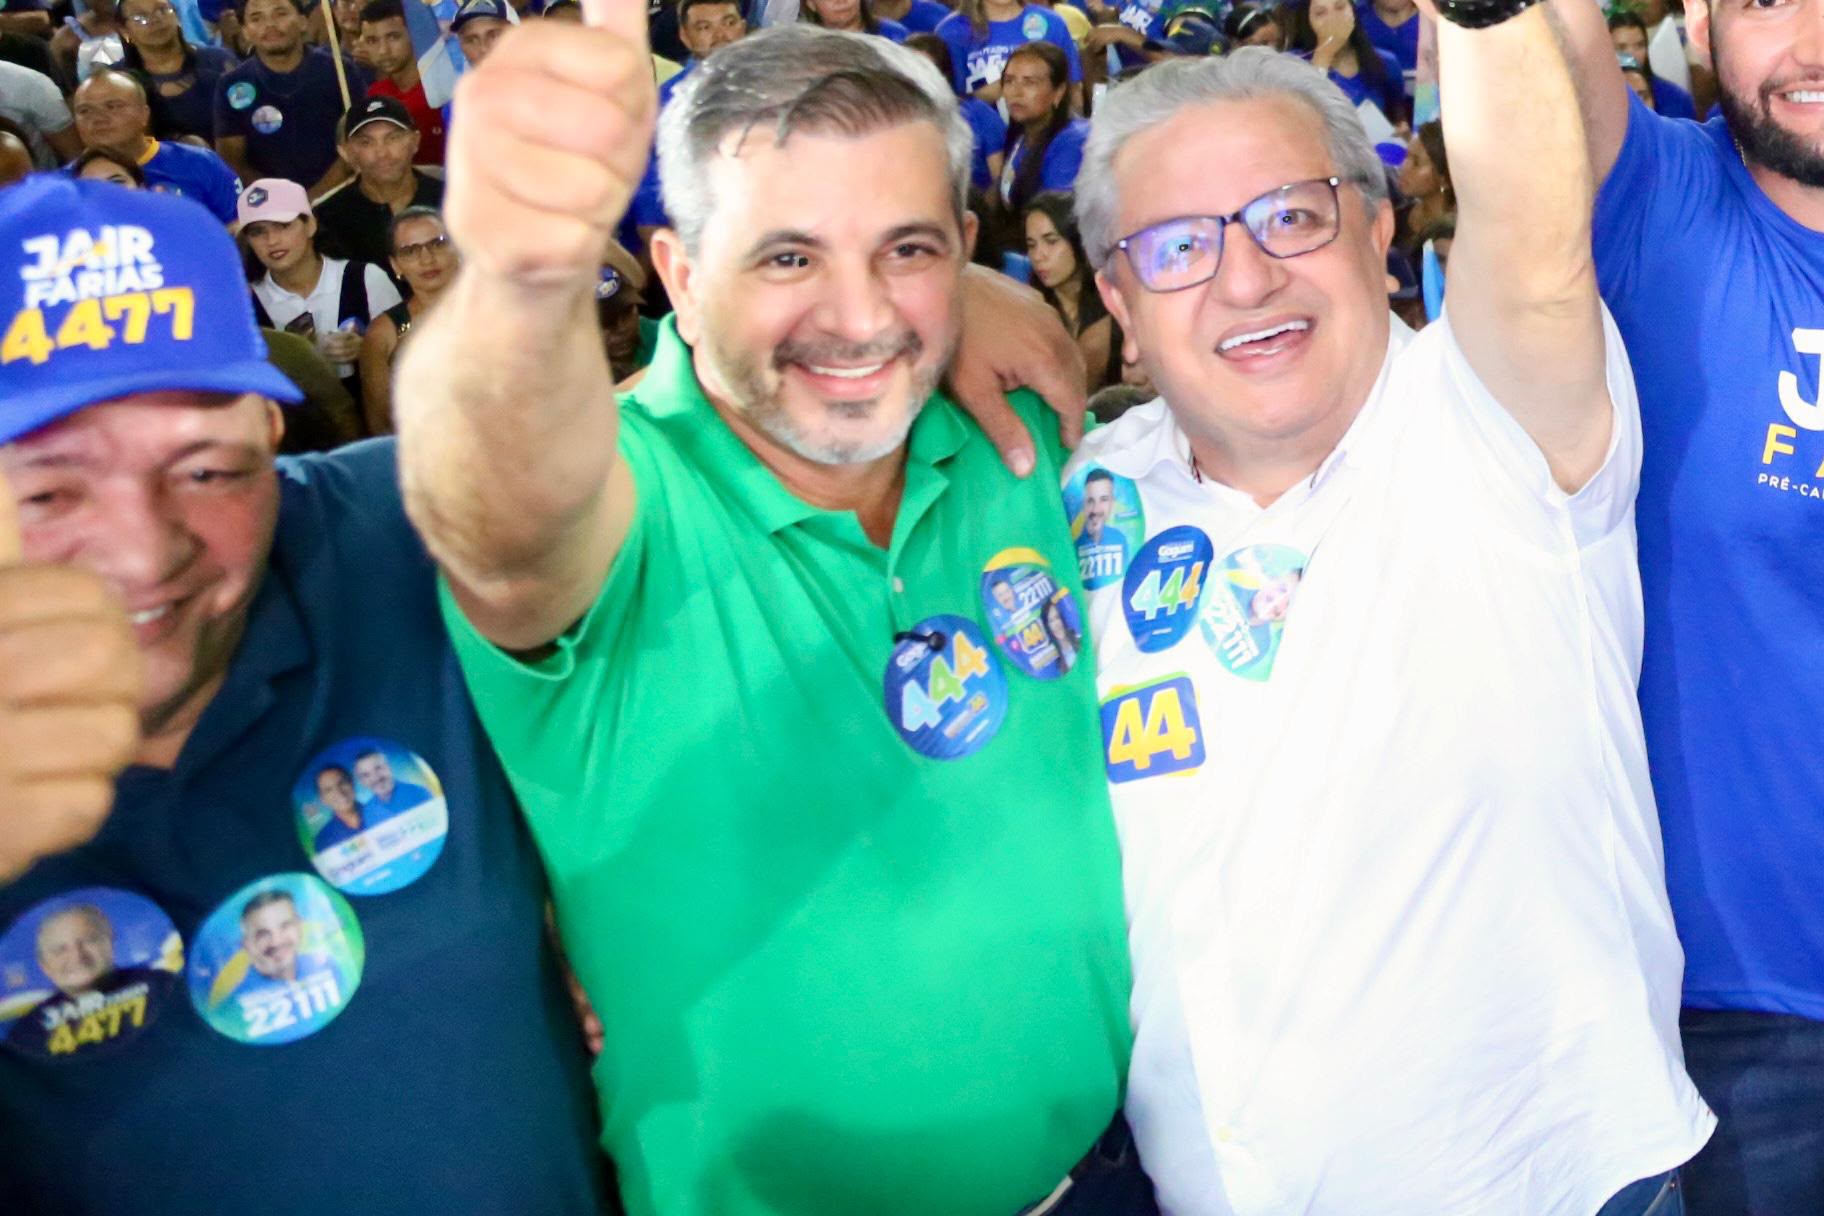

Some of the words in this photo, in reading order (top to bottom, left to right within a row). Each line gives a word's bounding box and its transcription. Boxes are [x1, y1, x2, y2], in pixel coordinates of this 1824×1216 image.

[21, 225, 157, 281] JAIR
[24, 263, 164, 310] FARIAS
[0, 287, 195, 366] 4477
[1130, 561, 1204, 621] 444
[902, 630, 990, 732] 444
[1109, 687, 1197, 770] 44
[48, 995, 148, 1055] 4477
[244, 977, 342, 1039] 22111
